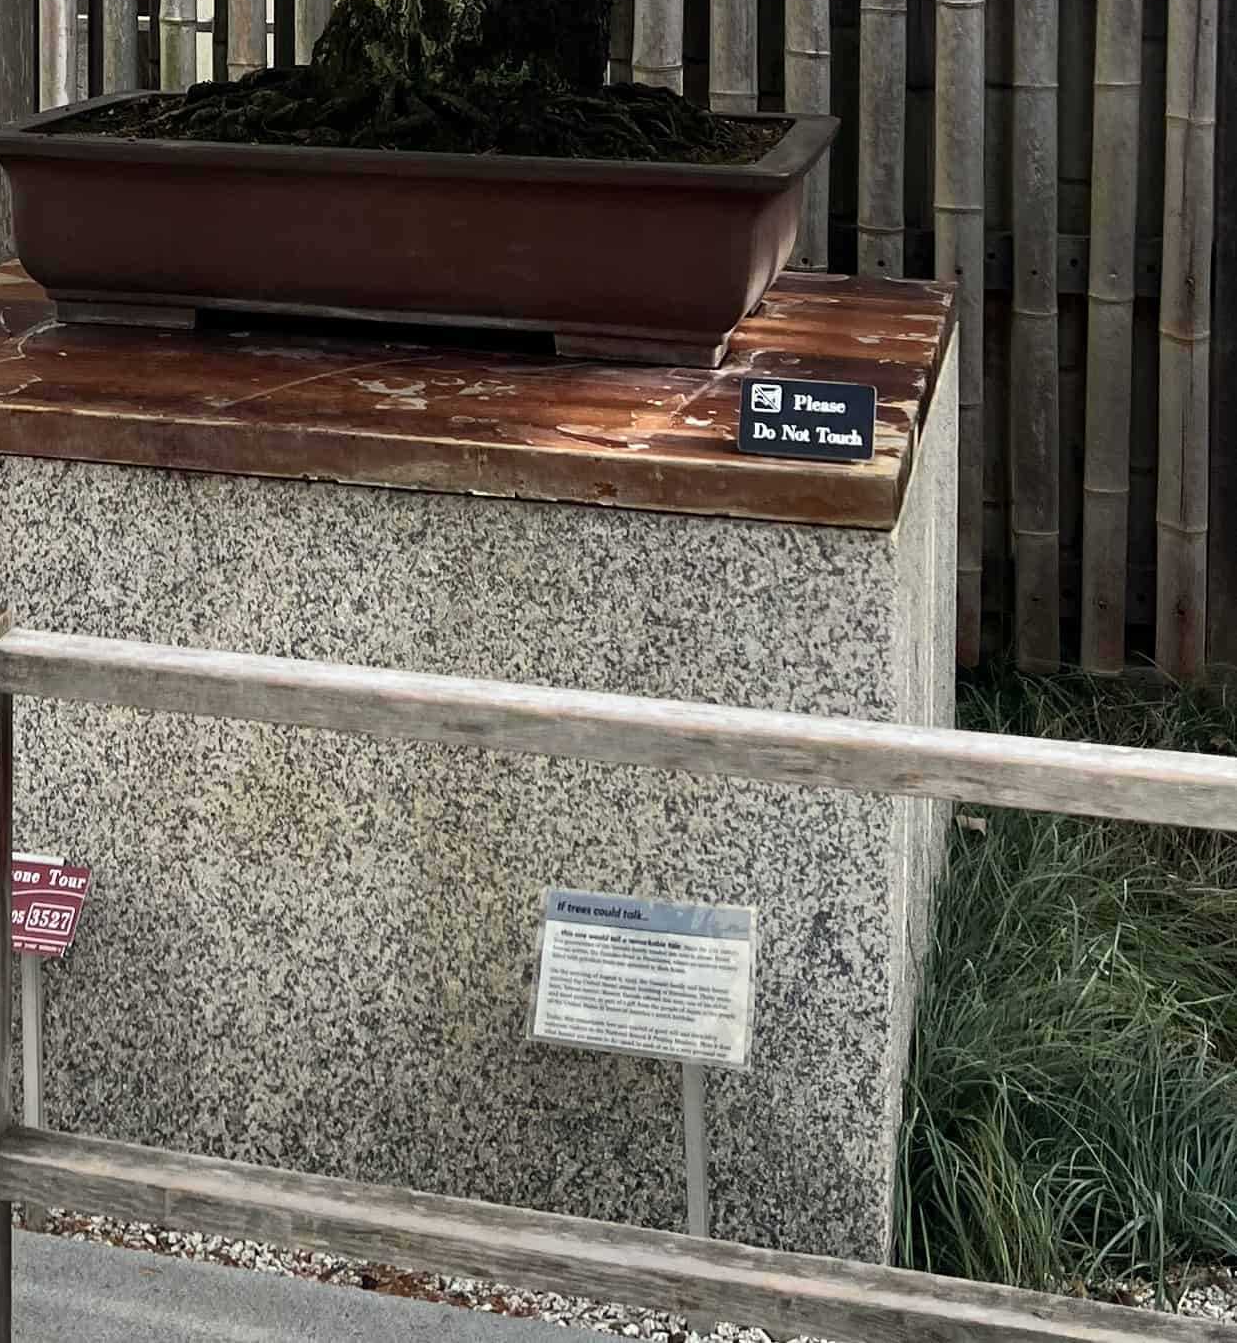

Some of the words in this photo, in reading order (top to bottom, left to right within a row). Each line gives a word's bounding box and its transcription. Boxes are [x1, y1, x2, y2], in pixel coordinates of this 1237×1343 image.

[793, 393, 846, 414] Please
[752, 422, 777, 440] Do
[781, 424, 811, 442] Not
[815, 426, 863, 446] Touch
[12, 869, 41, 884] one
[48, 869, 86, 889] Tour
[29, 908, 71, 930] 3527
[557, 900, 567, 912] If
[567, 903, 592, 916] trees
[593, 906, 622, 919] could
